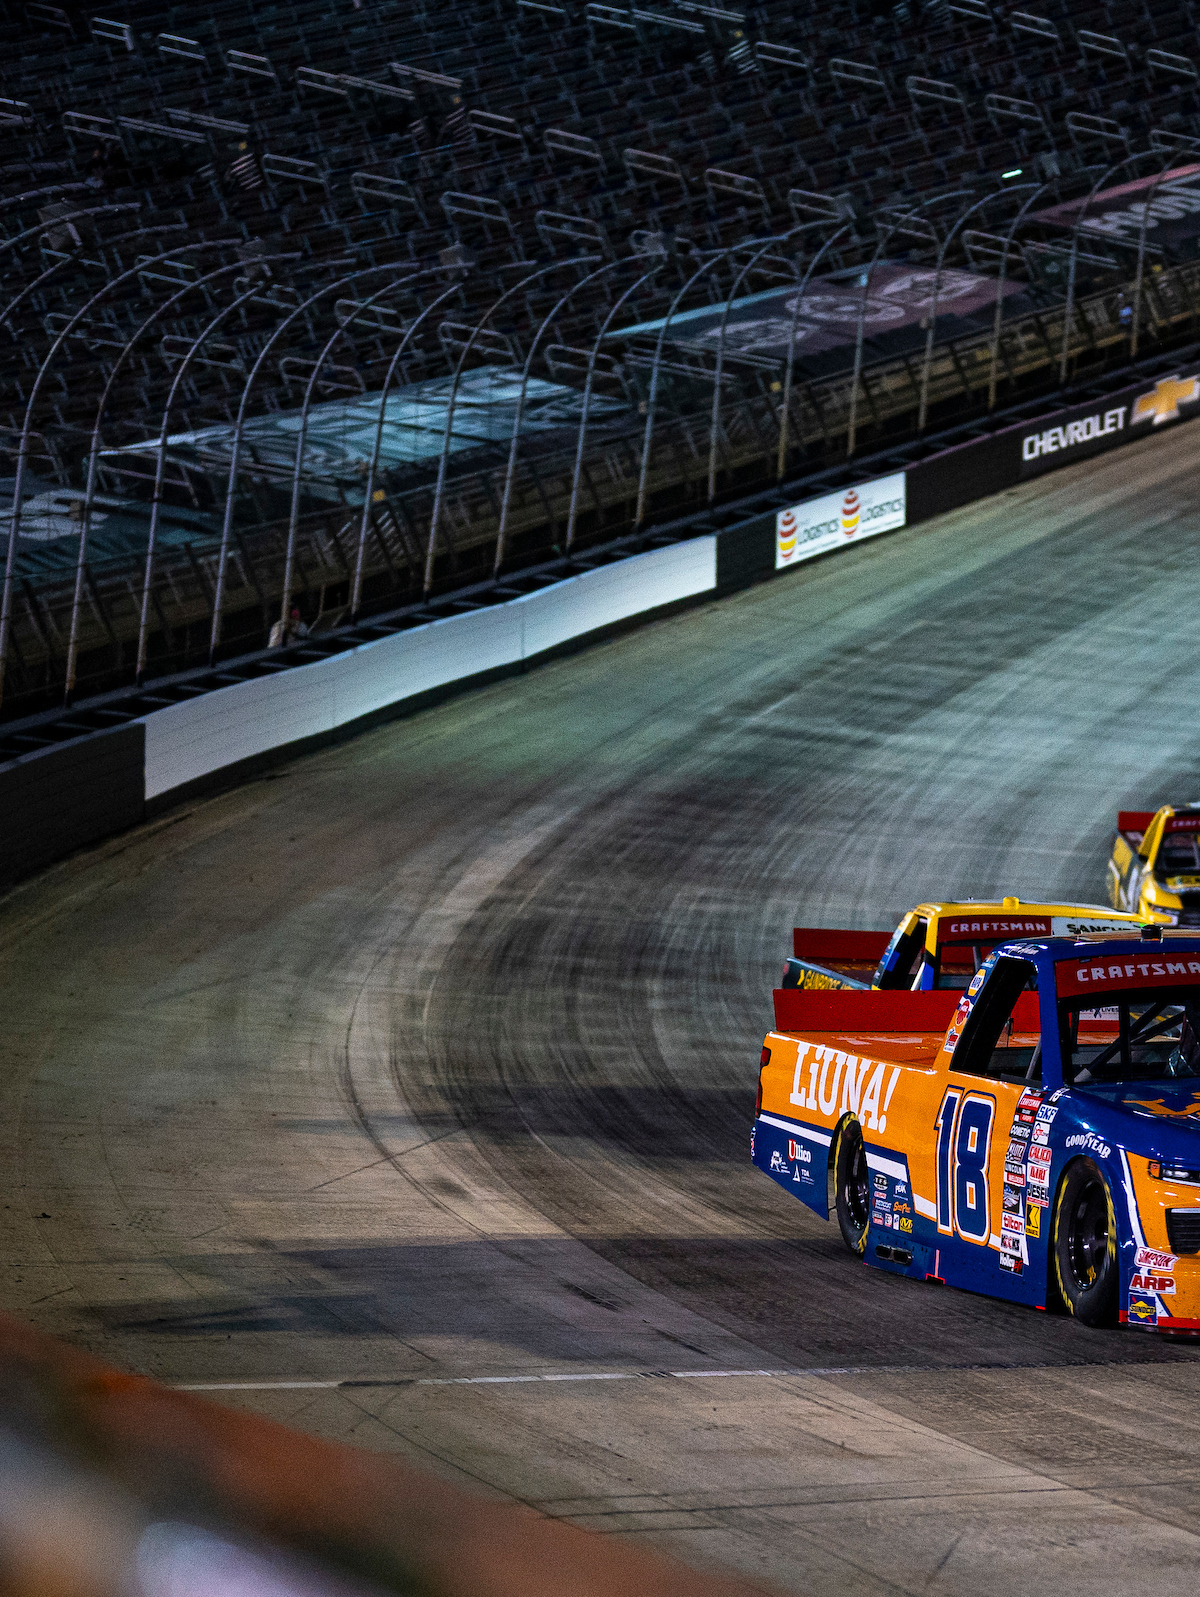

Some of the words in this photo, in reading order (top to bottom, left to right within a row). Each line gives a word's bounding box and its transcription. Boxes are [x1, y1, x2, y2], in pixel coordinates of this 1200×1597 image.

[1023, 406, 1127, 461] CHEVROLET
[950, 921, 1047, 933] CRAFTSMAN
[789, 1042, 902, 1135] LiUNA!
[1038, 1106, 1057, 1121] SKF
[788, 1139, 812, 1163] Ullico
[1029, 1145, 1052, 1162] CALICO
[935, 1085, 997, 1247] 18
[1027, 1182, 1049, 1201] JESEL
[1003, 1214, 1024, 1232] tilton
[1138, 1249, 1175, 1268] SIMPSON
[1131, 1276, 1175, 1291] ARP
[1129, 1304, 1156, 1316] SUNOCO
